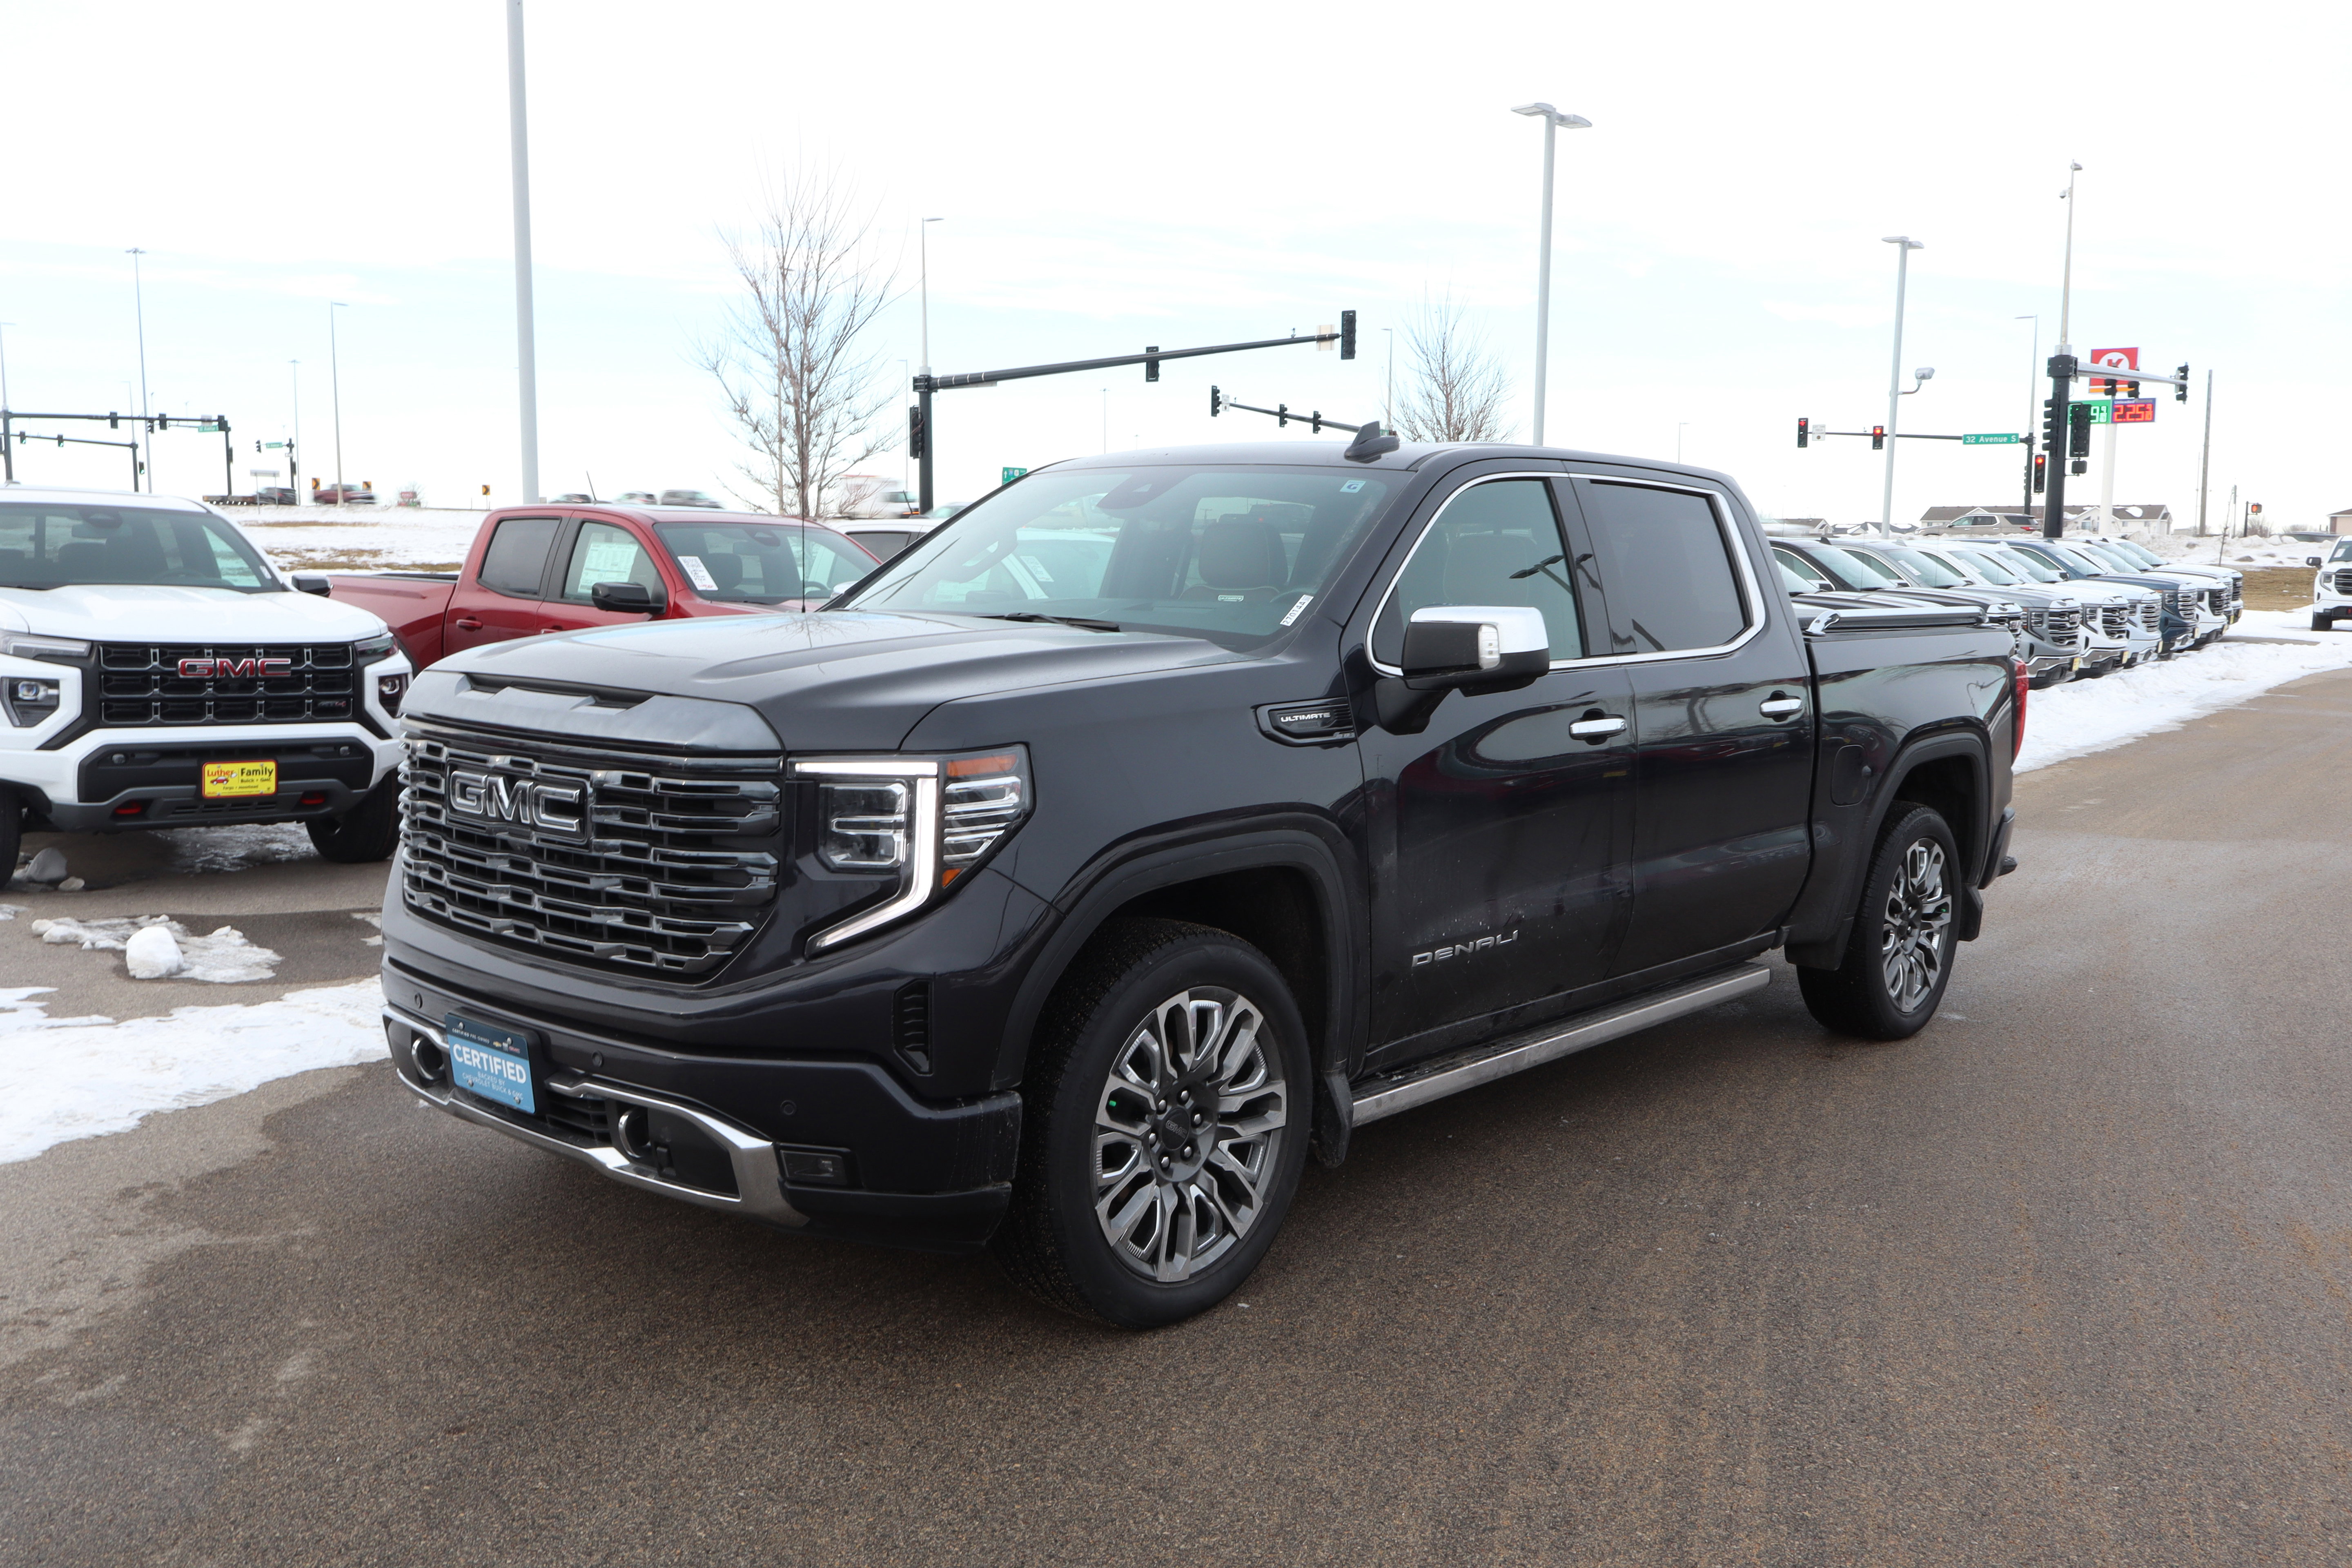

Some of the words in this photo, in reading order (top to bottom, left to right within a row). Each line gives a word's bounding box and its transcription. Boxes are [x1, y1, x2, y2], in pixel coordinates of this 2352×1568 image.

[178, 658, 291, 678] GMC
[1281, 712, 1331, 722] ULTIMATE
[207, 768, 234, 777] Luther
[241, 766, 274, 777] Family
[450, 771, 580, 832] GMC
[1412, 930, 1518, 967] DENALI
[452, 1027, 470, 1038] CERTIFIED
[453, 1043, 526, 1084] CERTIFIED
[462, 1072, 490, 1087] CHEVROLET
[477, 1071, 498, 1084] BACKED
[1166, 1120, 1187, 1138] GMC
